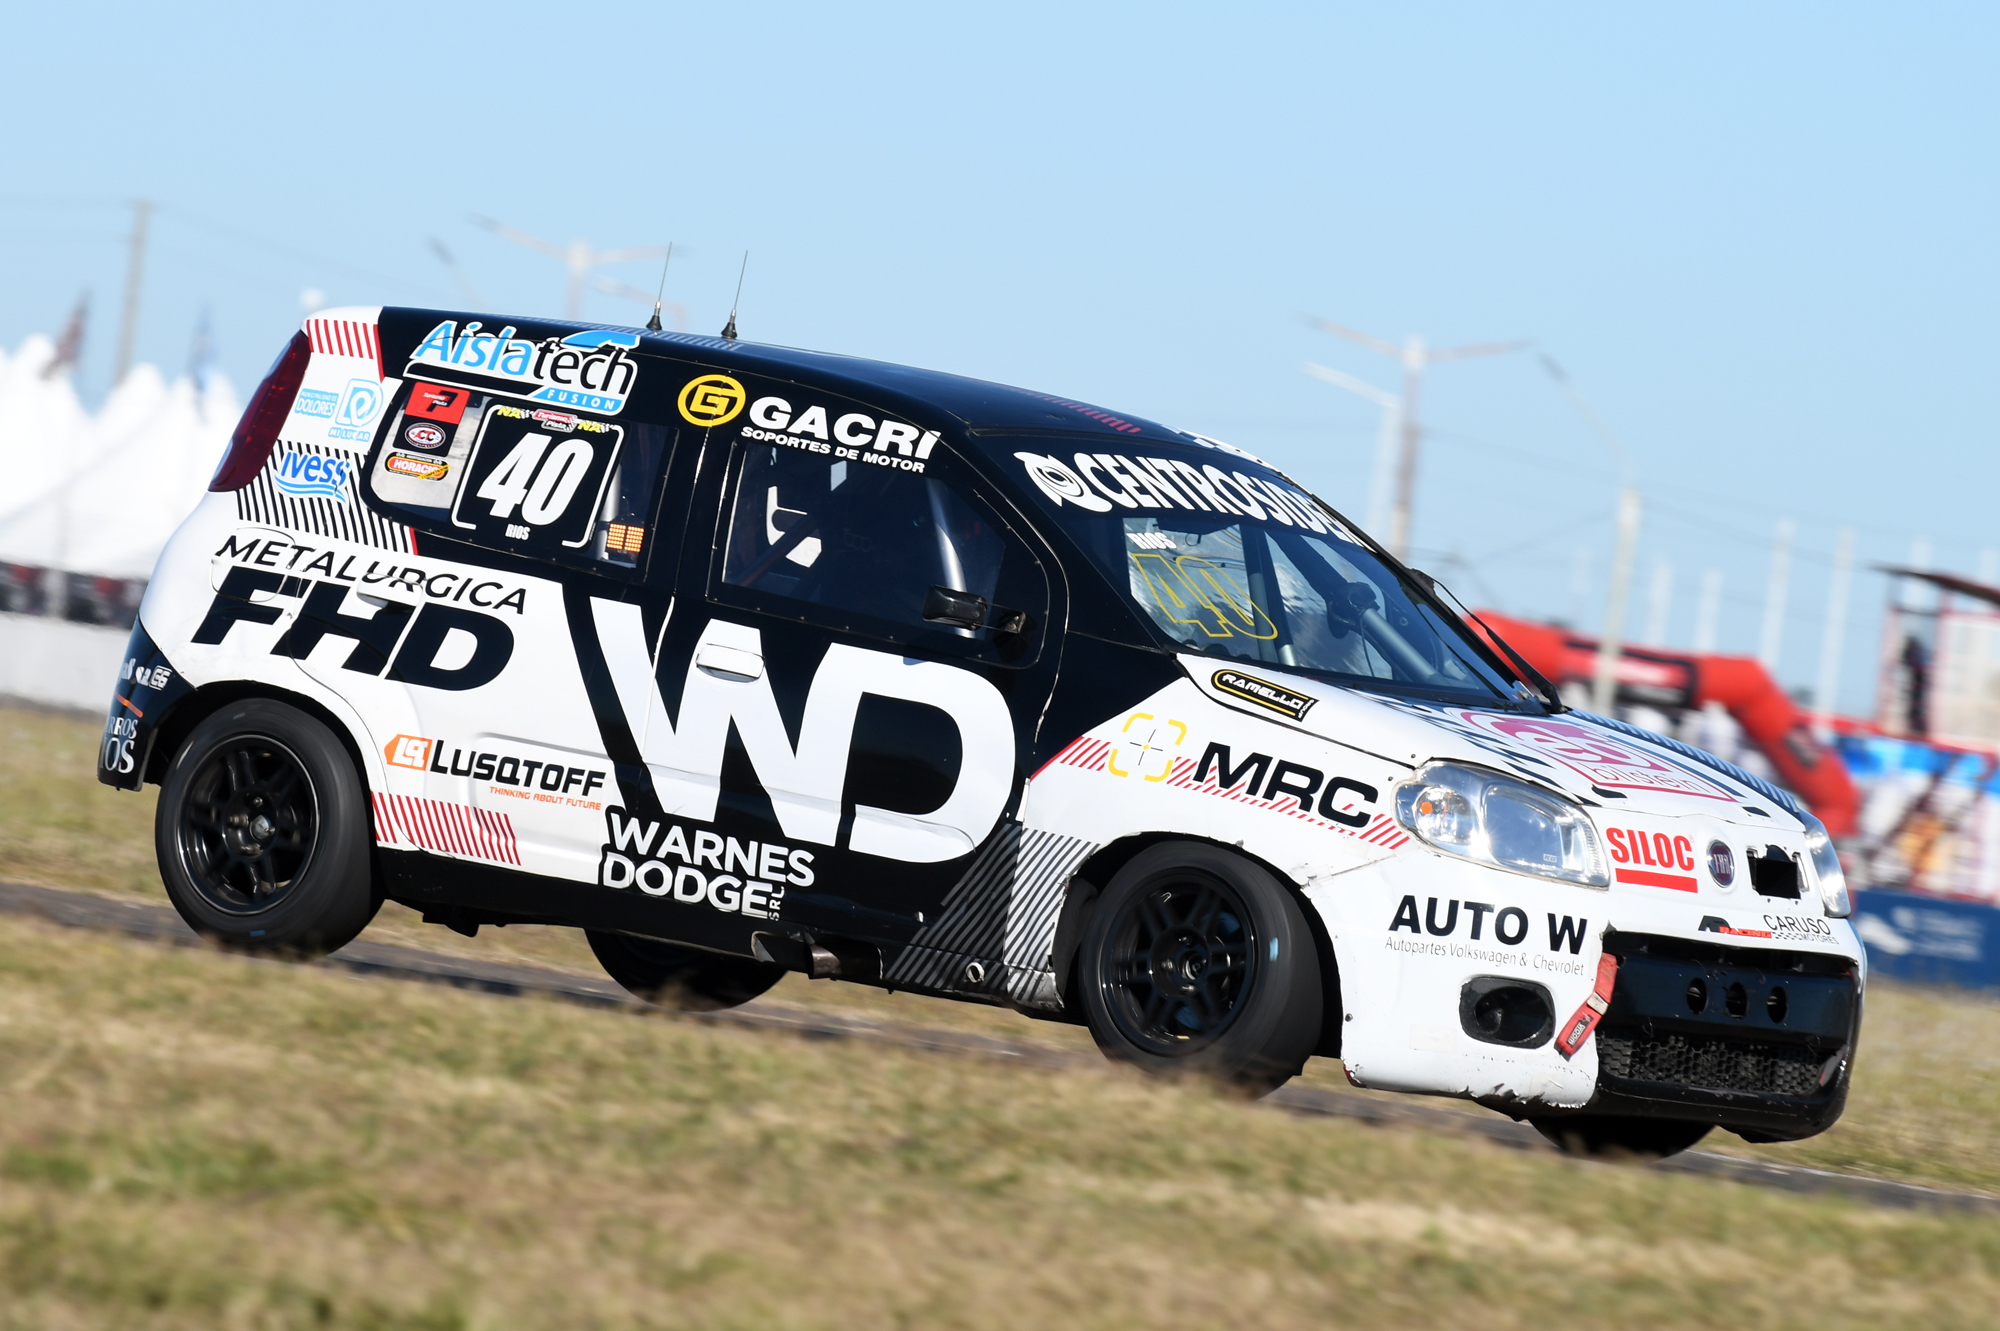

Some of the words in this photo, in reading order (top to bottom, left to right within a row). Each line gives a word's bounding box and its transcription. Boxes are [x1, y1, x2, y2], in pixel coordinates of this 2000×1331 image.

[412, 321, 635, 396] Aislatech
[296, 398, 336, 416] DOLORES
[538, 412, 569, 422] Turismo
[547, 389, 616, 410] FUSION
[329, 427, 340, 437] MI
[741, 426, 831, 455] SOPORTES
[834, 446, 859, 460] DE
[862, 452, 926, 473] MOTOR
[749, 396, 941, 460] GACRI
[476, 432, 594, 525] 40
[505, 523, 531, 540] RIOS
[1126, 532, 1177, 550] RIOS
[214, 534, 527, 615] METALURGICA
[1130, 553, 1278, 640] 40
[191, 565, 514, 691] FHD
[1222, 674, 1304, 709] RAMELLO
[590, 596, 1016, 863] WD
[430, 739, 606, 796] LUSQTOFF
[1193, 741, 1378, 828] MRC
[1578, 762, 1711, 793] bilstein
[489, 786, 530, 799] THINKING
[533, 792, 563, 805] ABOUT
[566, 798, 602, 810] FUTURE
[610, 812, 815, 888] WARNES
[1606, 827, 1695, 872] SILOC
[603, 851, 773, 919] DODGE
[769, 885, 786, 921] SRL
[1388, 894, 1529, 946] AUTO
[1547, 912, 1588, 955] W
[1718, 926, 1772, 938] RACING
[1763, 914, 1831, 935] CARUSO
[1801, 933, 1840, 945] MOTORES
[1385, 936, 1447, 956] Autopartes
[1450, 943, 1517, 967] Volkswagen
[1519, 953, 1528, 967] &
[1533, 954, 1584, 976] Chevrolet
